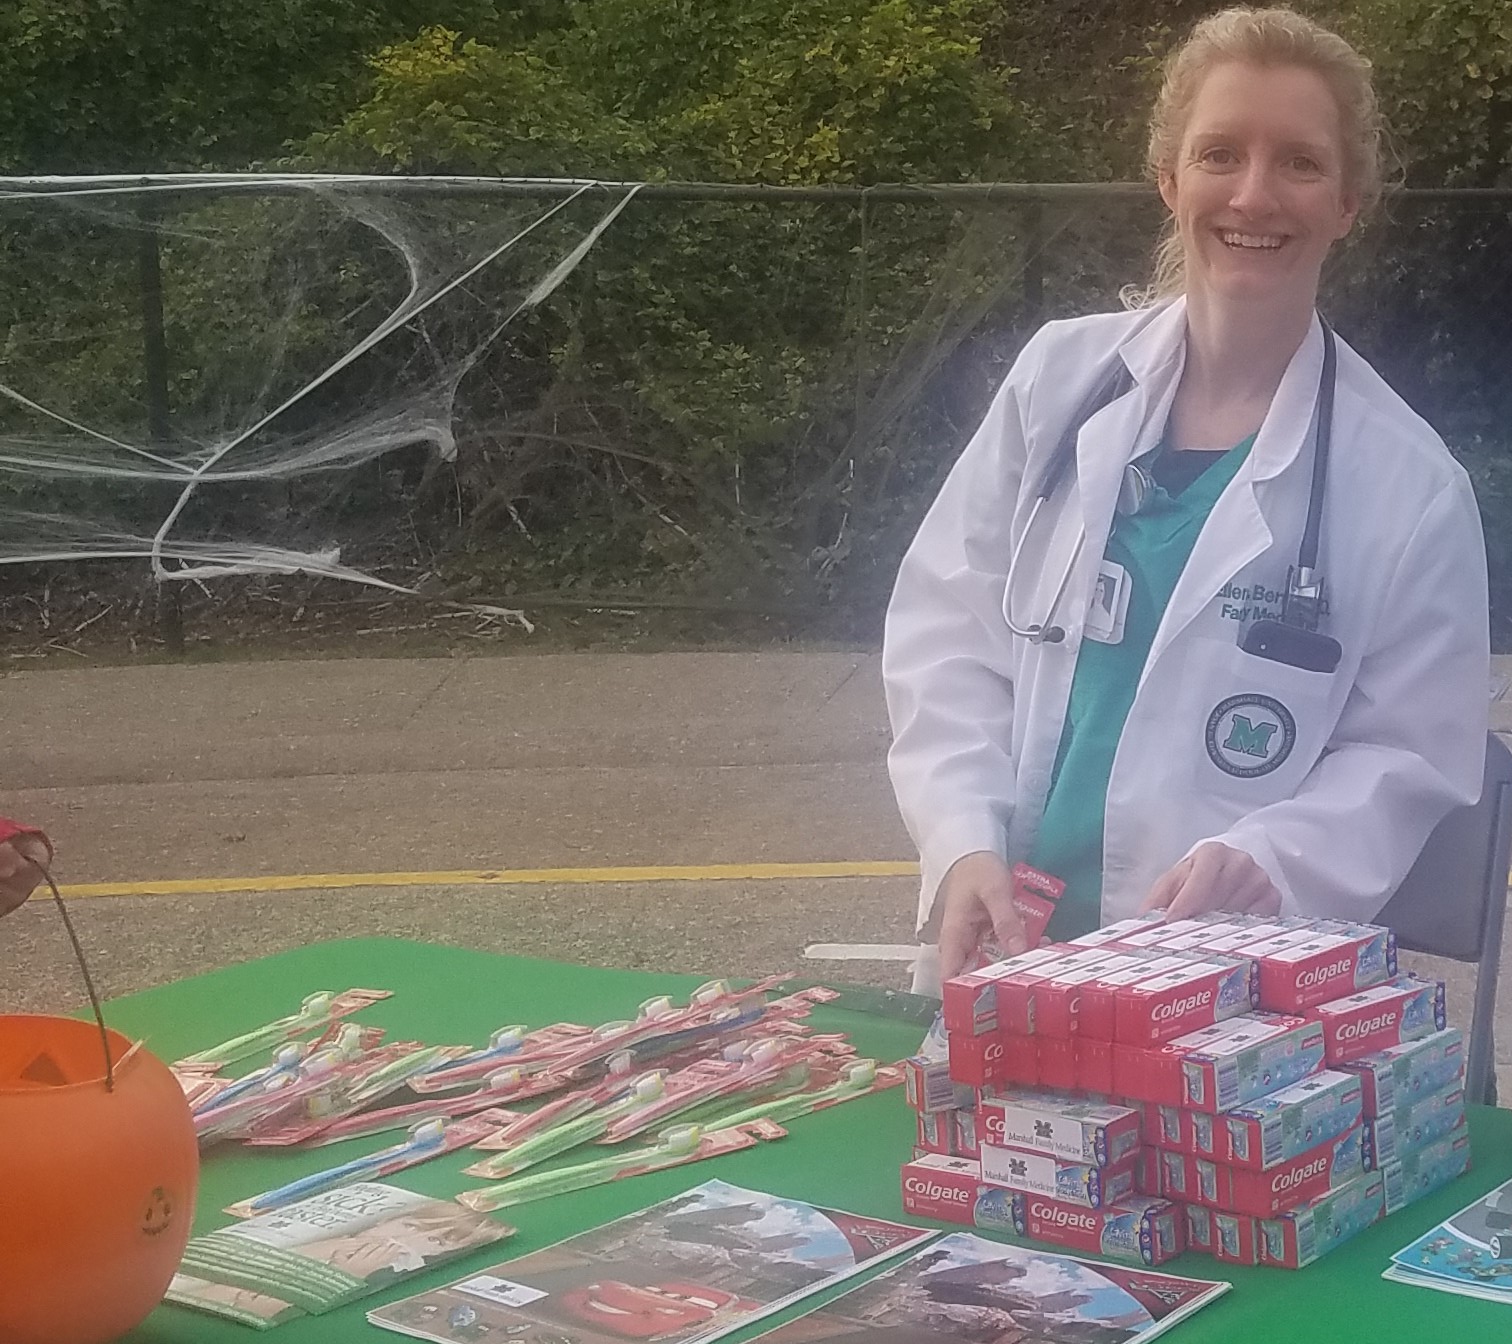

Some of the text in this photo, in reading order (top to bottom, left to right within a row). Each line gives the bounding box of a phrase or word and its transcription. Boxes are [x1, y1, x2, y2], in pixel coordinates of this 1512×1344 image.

[1295, 958, 1352, 988] Colgate
[1151, 989, 1212, 1022] Colgate
[1335, 1012, 1397, 1041] Colgate
[904, 1176, 970, 1203] Colgate
[1271, 1157, 1327, 1193] Colgate
[1031, 1202, 1096, 1231] Colgate
